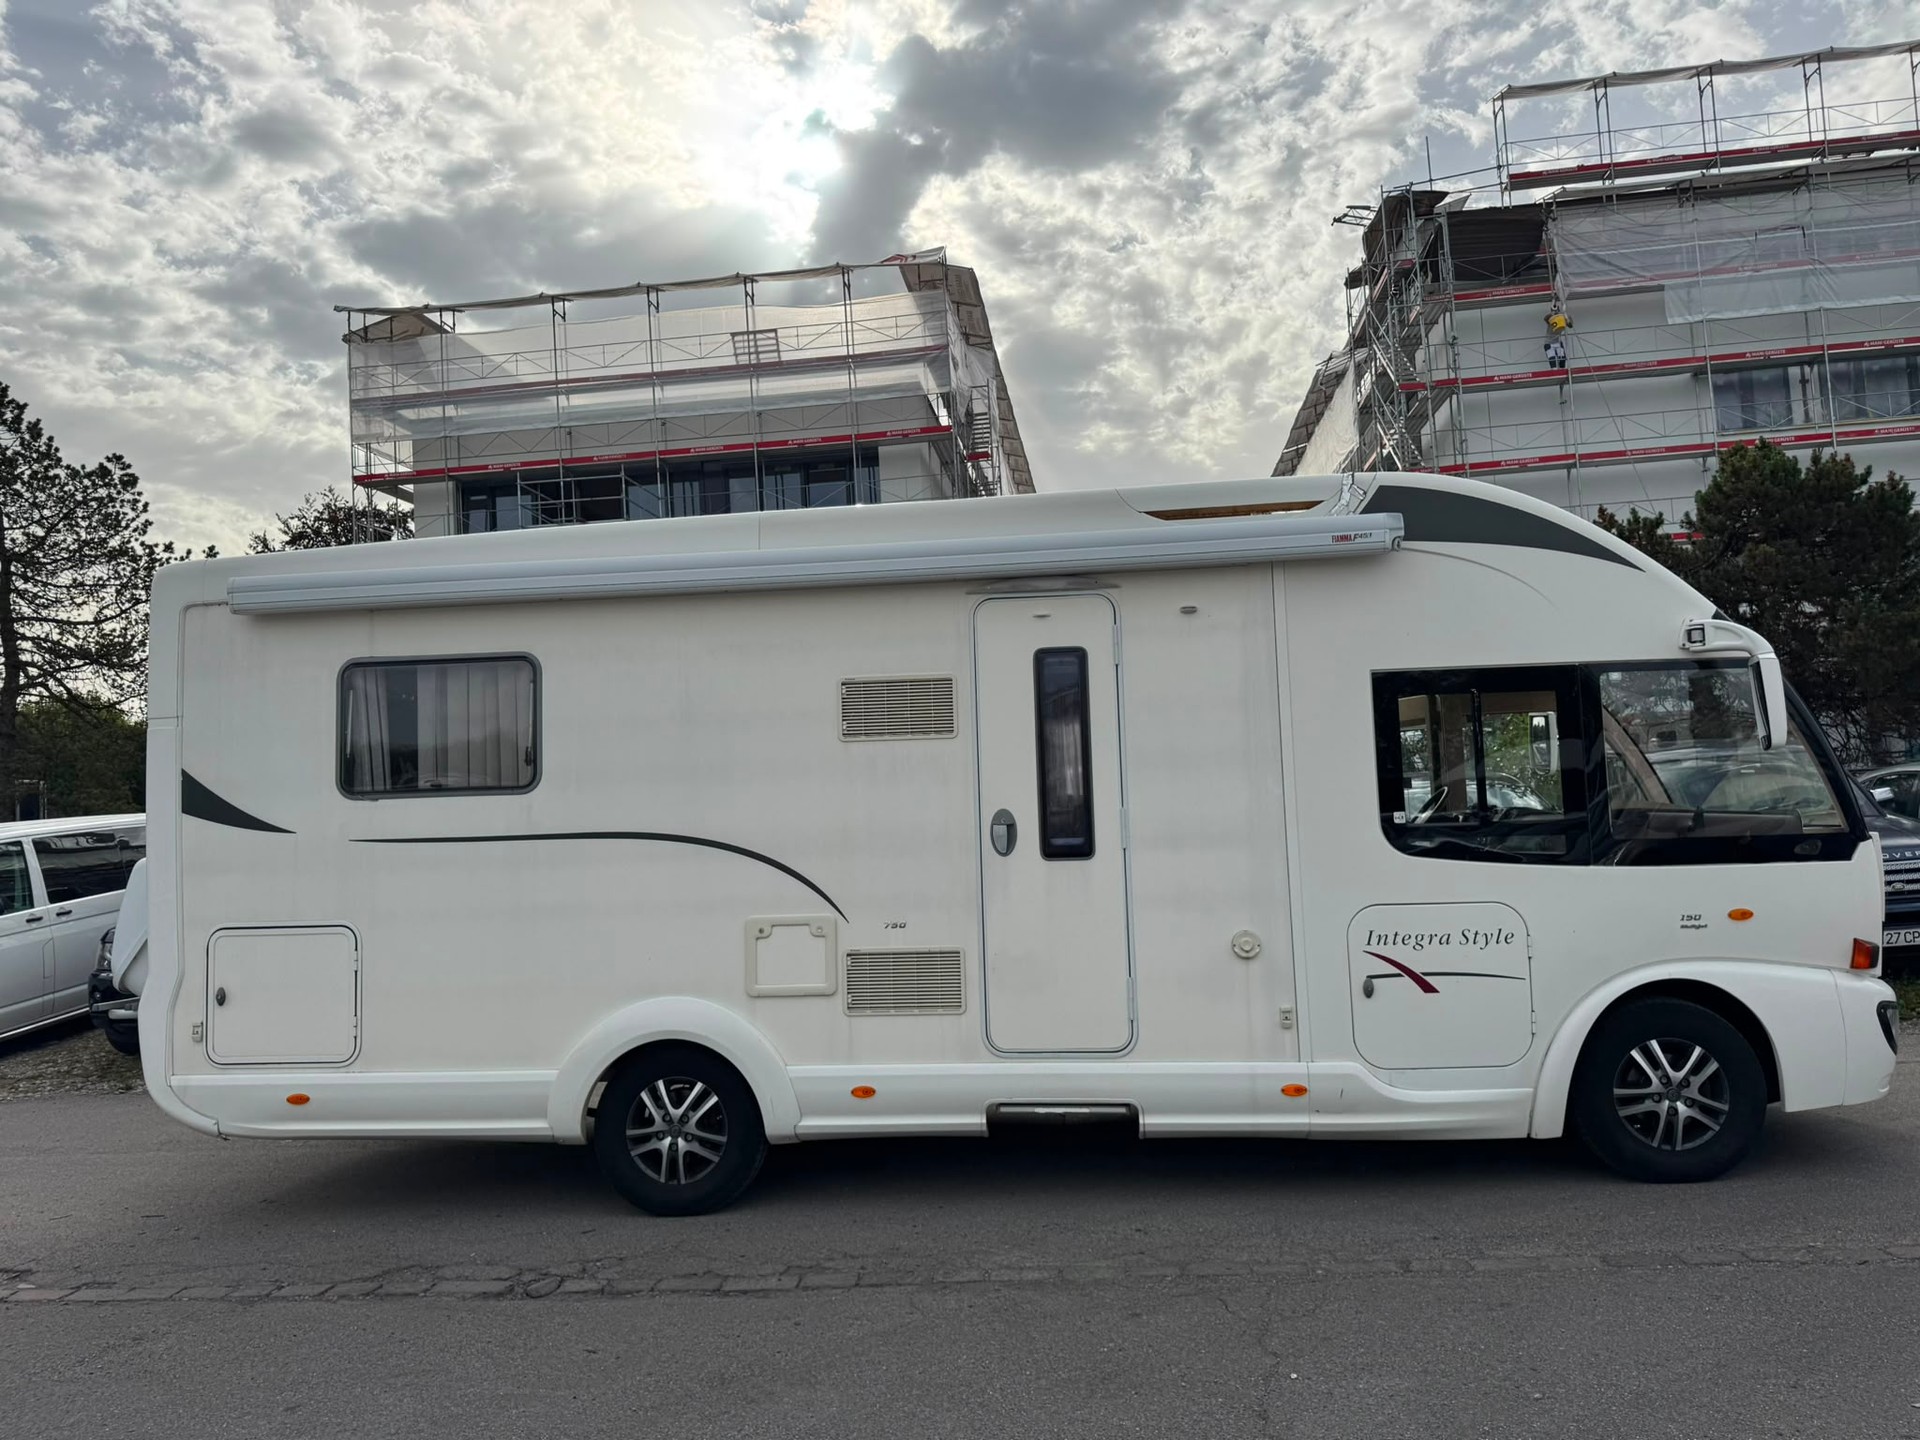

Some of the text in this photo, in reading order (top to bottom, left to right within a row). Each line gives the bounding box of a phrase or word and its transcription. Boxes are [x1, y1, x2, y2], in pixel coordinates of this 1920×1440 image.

[1332, 533, 1352, 543] FIAMMA
[884, 921, 907, 929] 750
[1365, 928, 1515, 951] Integra Style
[1885, 932, 1901, 945] 27
